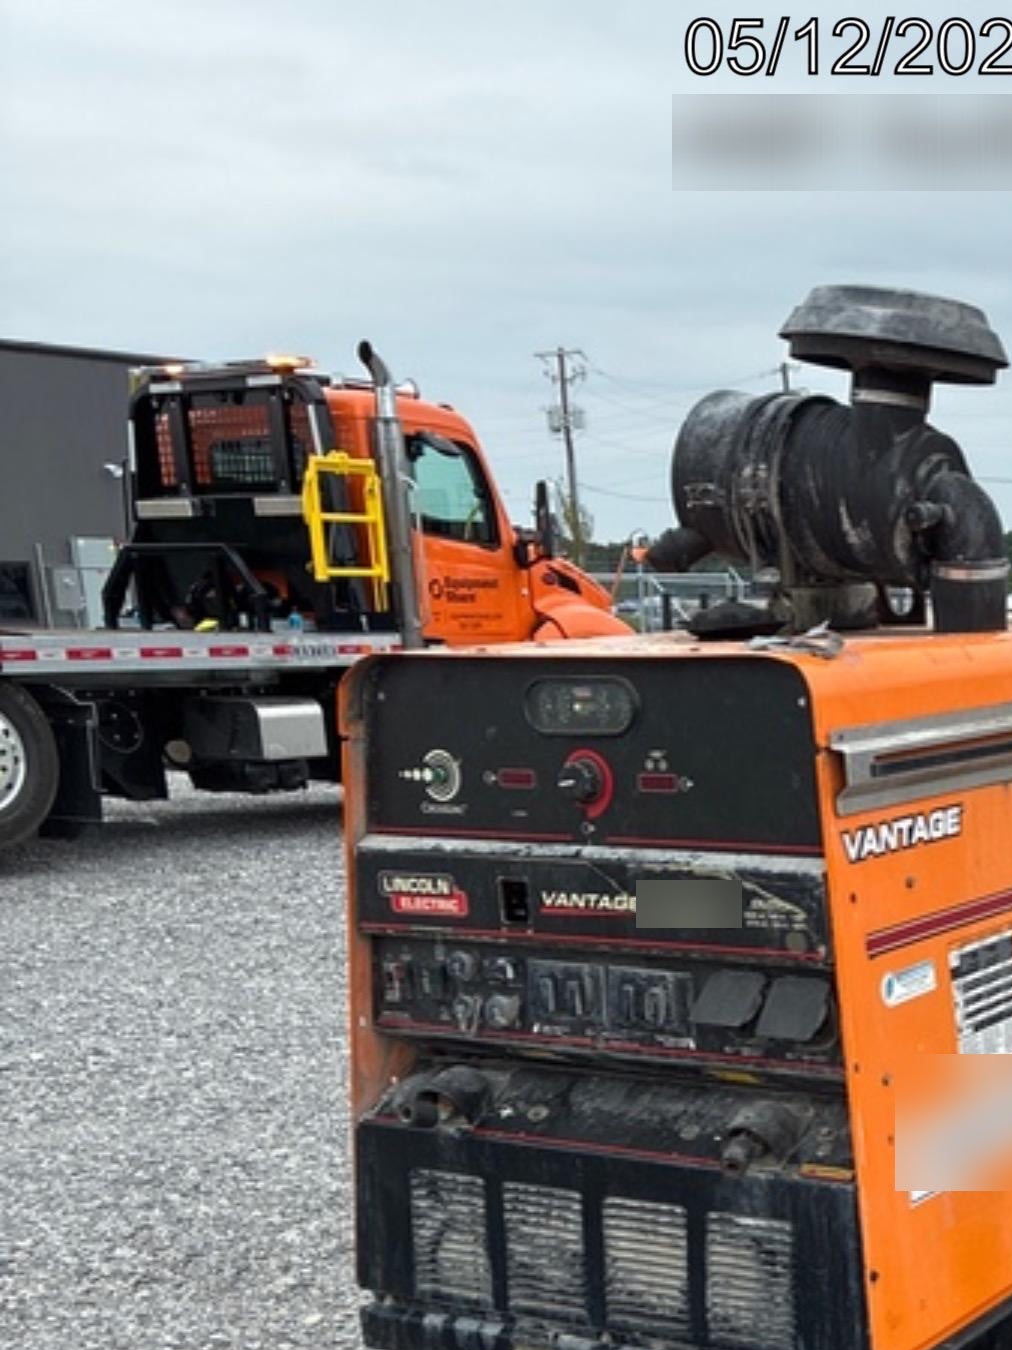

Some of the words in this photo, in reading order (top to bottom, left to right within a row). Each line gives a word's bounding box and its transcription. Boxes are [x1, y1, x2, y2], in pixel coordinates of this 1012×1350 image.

[841, 804, 963, 864] VANTAGE
[382, 875, 451, 895] LINCOLN
[399, 896, 459, 911] ELECTRIC
